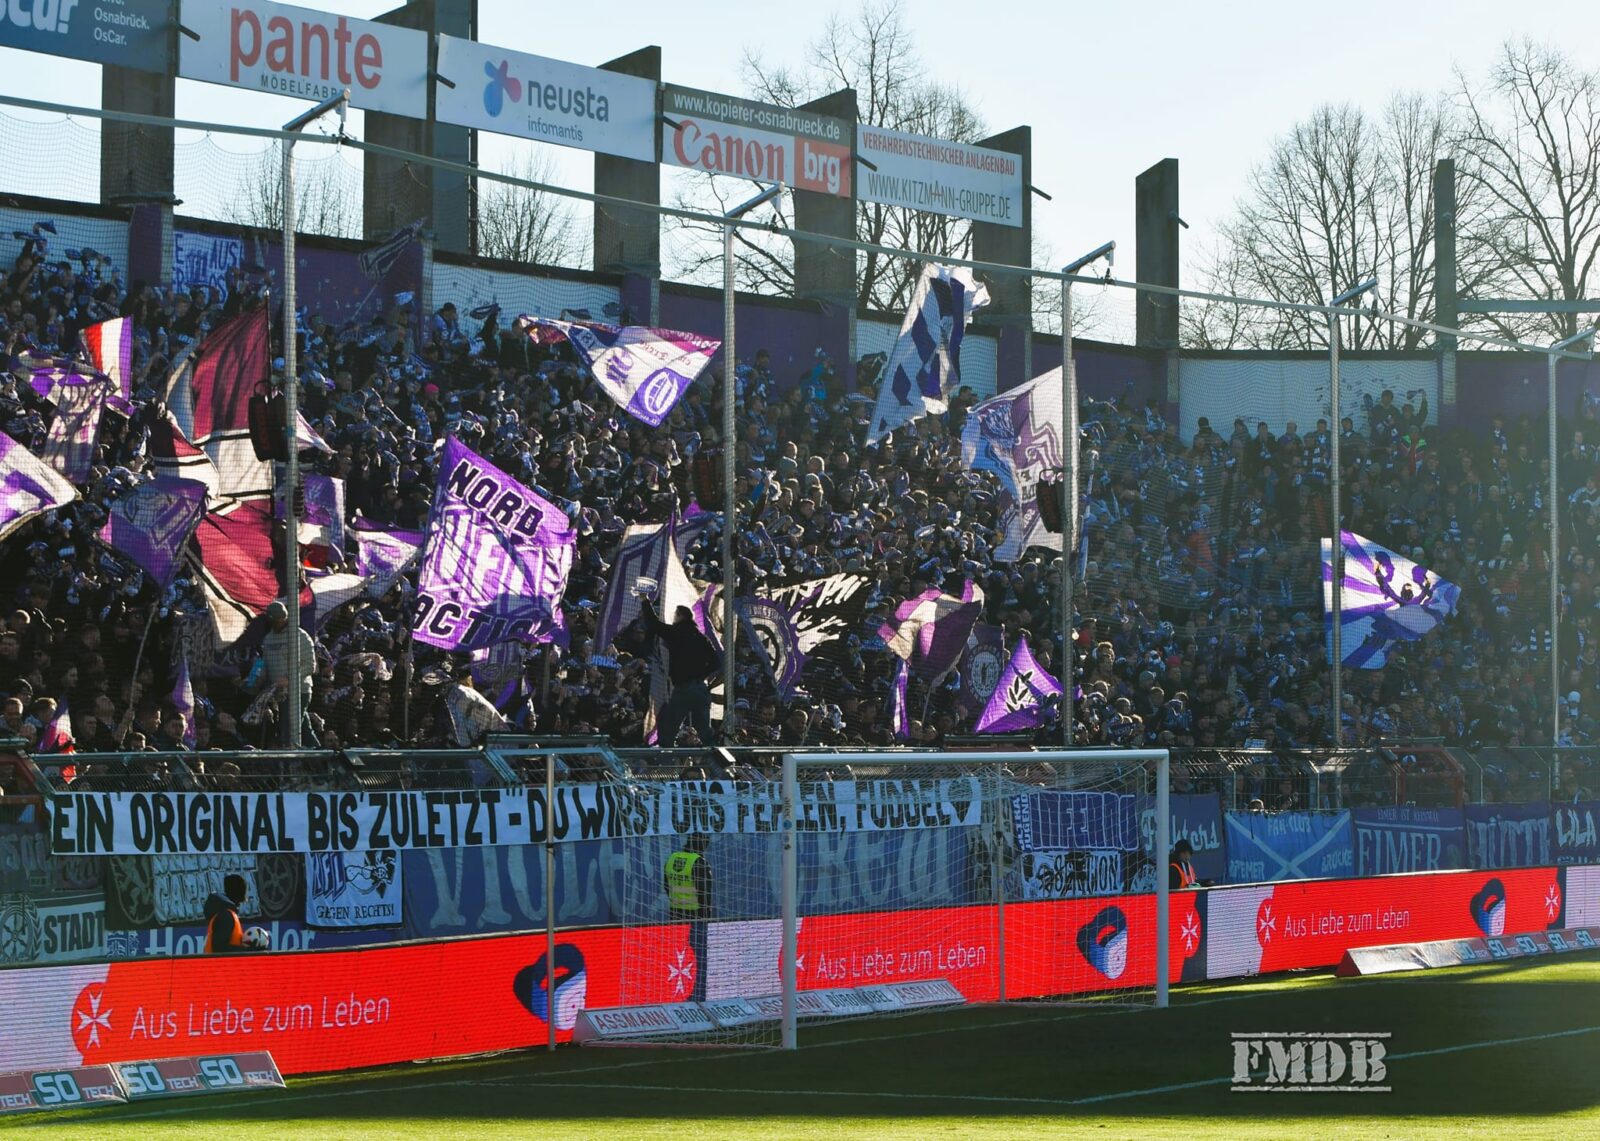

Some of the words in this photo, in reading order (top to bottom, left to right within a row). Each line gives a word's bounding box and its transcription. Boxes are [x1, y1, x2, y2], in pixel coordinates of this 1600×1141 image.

[94, 8, 150, 30] Osnabrück.
[94, 27, 127, 45] OsCar.
[230, 7, 383, 89] pante
[260, 73, 345, 98] MÖBELFABR
[527, 80, 609, 122] neusta
[527, 115, 584, 142] infomantis
[674, 93, 840, 140] www.kopierer-osnabrueck.de
[673, 119, 785, 181] Canon
[803, 142, 840, 194] brg
[863, 132, 964, 165] VERFAHRENSTECHNISCHER
[965, 152, 1015, 175] ANLAGENBAU
[868, 173, 1010, 219] WWW.KITZMANN-GRUPPE.DE
[447, 458, 545, 538] NORD
[52, 793, 114, 853] EIN
[130, 793, 295, 852] ORIGINAL
[307, 793, 359, 851] BIS
[368, 790, 500, 849] ZULETZT
[670, 781, 726, 834] UNS
[1357, 828, 1441, 876] EIMER
[354, 903, 395, 919] RECHTS!
[1284, 915, 1307, 938] Aus
[1311, 910, 1344, 936] Liebe
[1347, 913, 1373, 933] zum
[1376, 905, 1410, 930] Leben
[817, 953, 847, 980] Aus
[852, 947, 895, 978] Liebe
[900, 950, 932, 974] zum
[938, 941, 986, 970] Leben
[129, 1006, 178, 1041] Aus
[188, 1000, 254, 1037] Liebe
[262, 1003, 313, 1033] zum
[321, 992, 390, 1028] Leben
[593, 1009, 670, 1031] ASSMANN
[34, 1073, 82, 1103] SO
[120, 1065, 166, 1093] SO
[166, 1076, 199, 1090] TECH
[200, 1058, 244, 1086] SO
